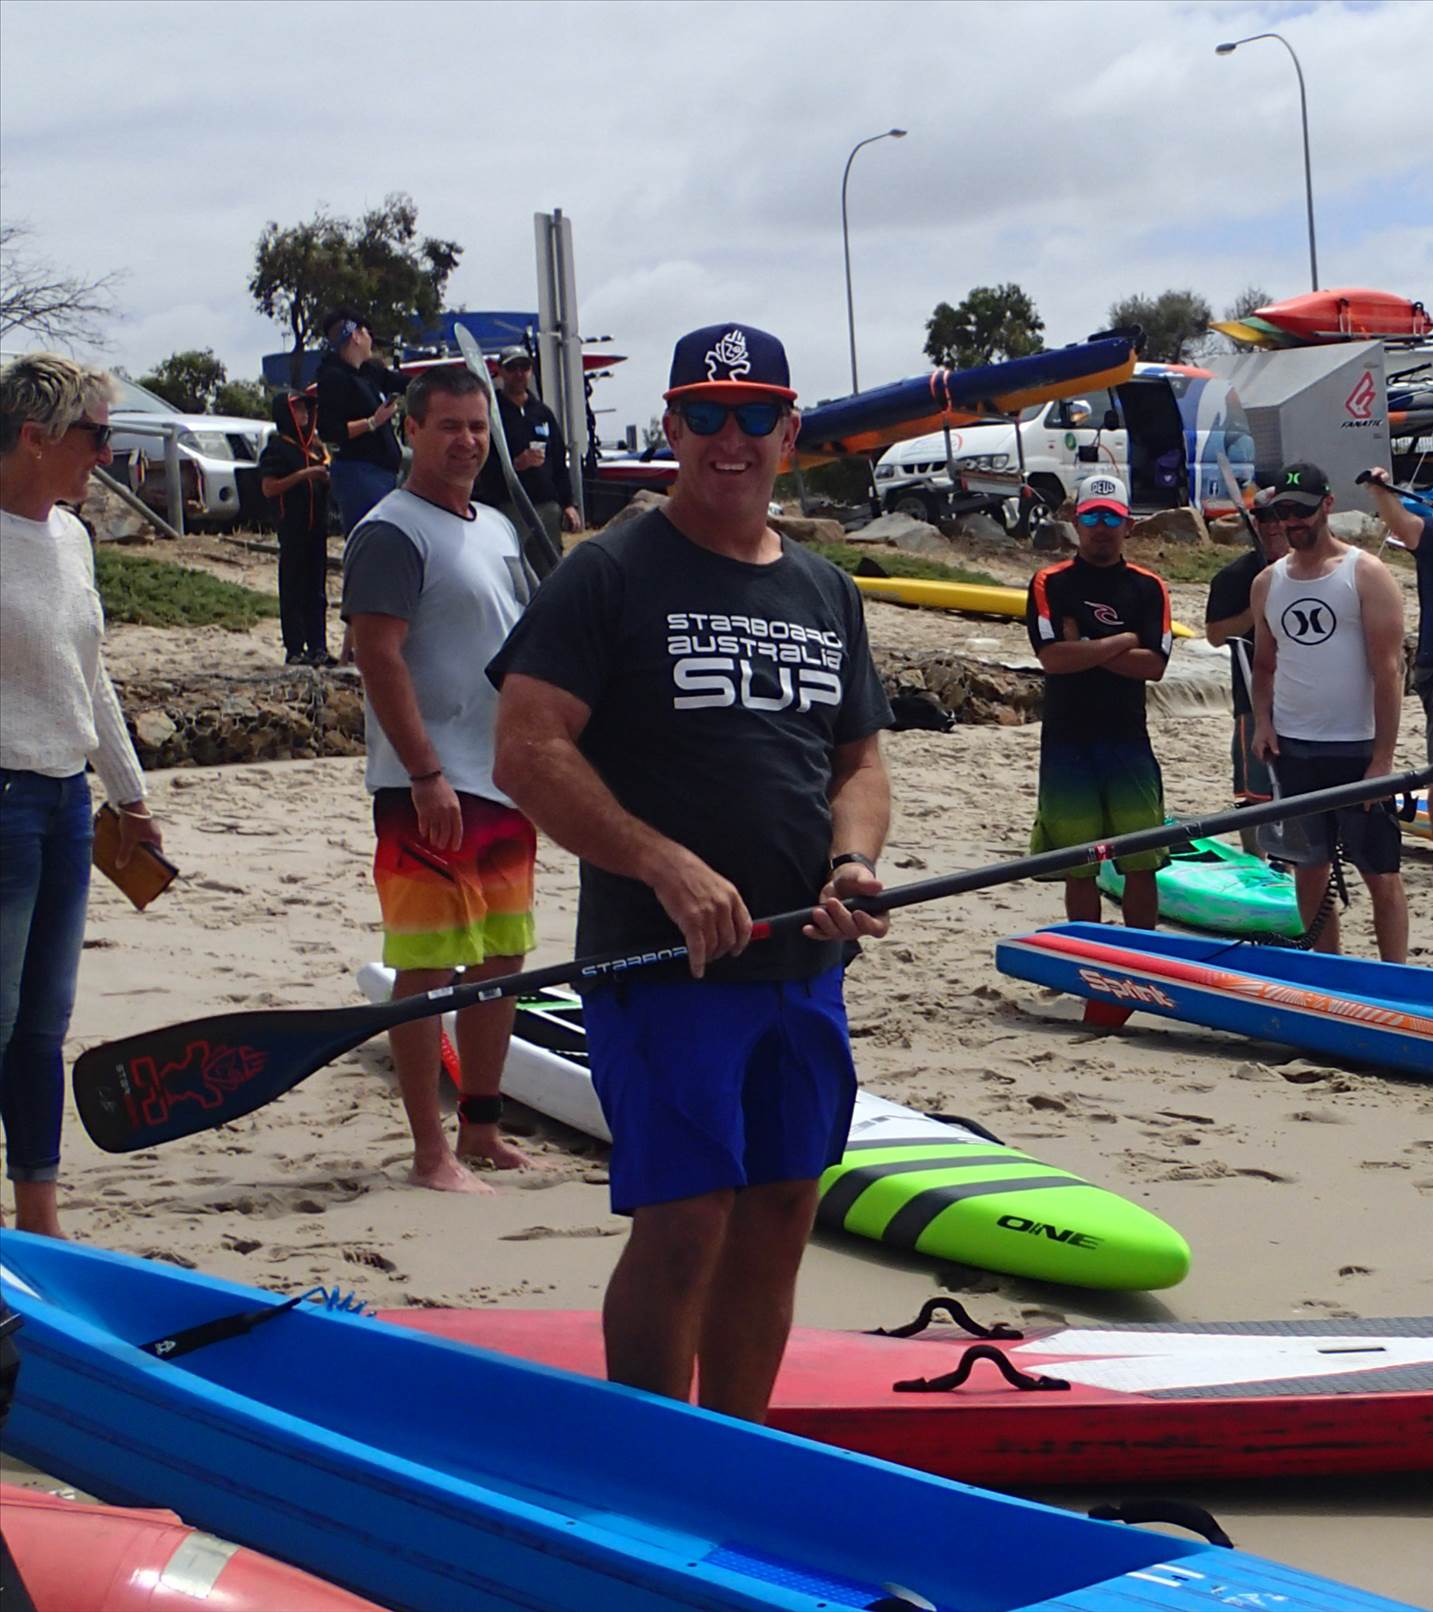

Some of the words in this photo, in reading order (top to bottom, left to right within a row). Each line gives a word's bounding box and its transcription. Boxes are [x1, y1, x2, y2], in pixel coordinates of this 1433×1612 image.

[1341, 420, 1383, 429] FANATIC
[673, 657, 843, 713] SUP
[996, 1214, 1105, 1250] ONE
